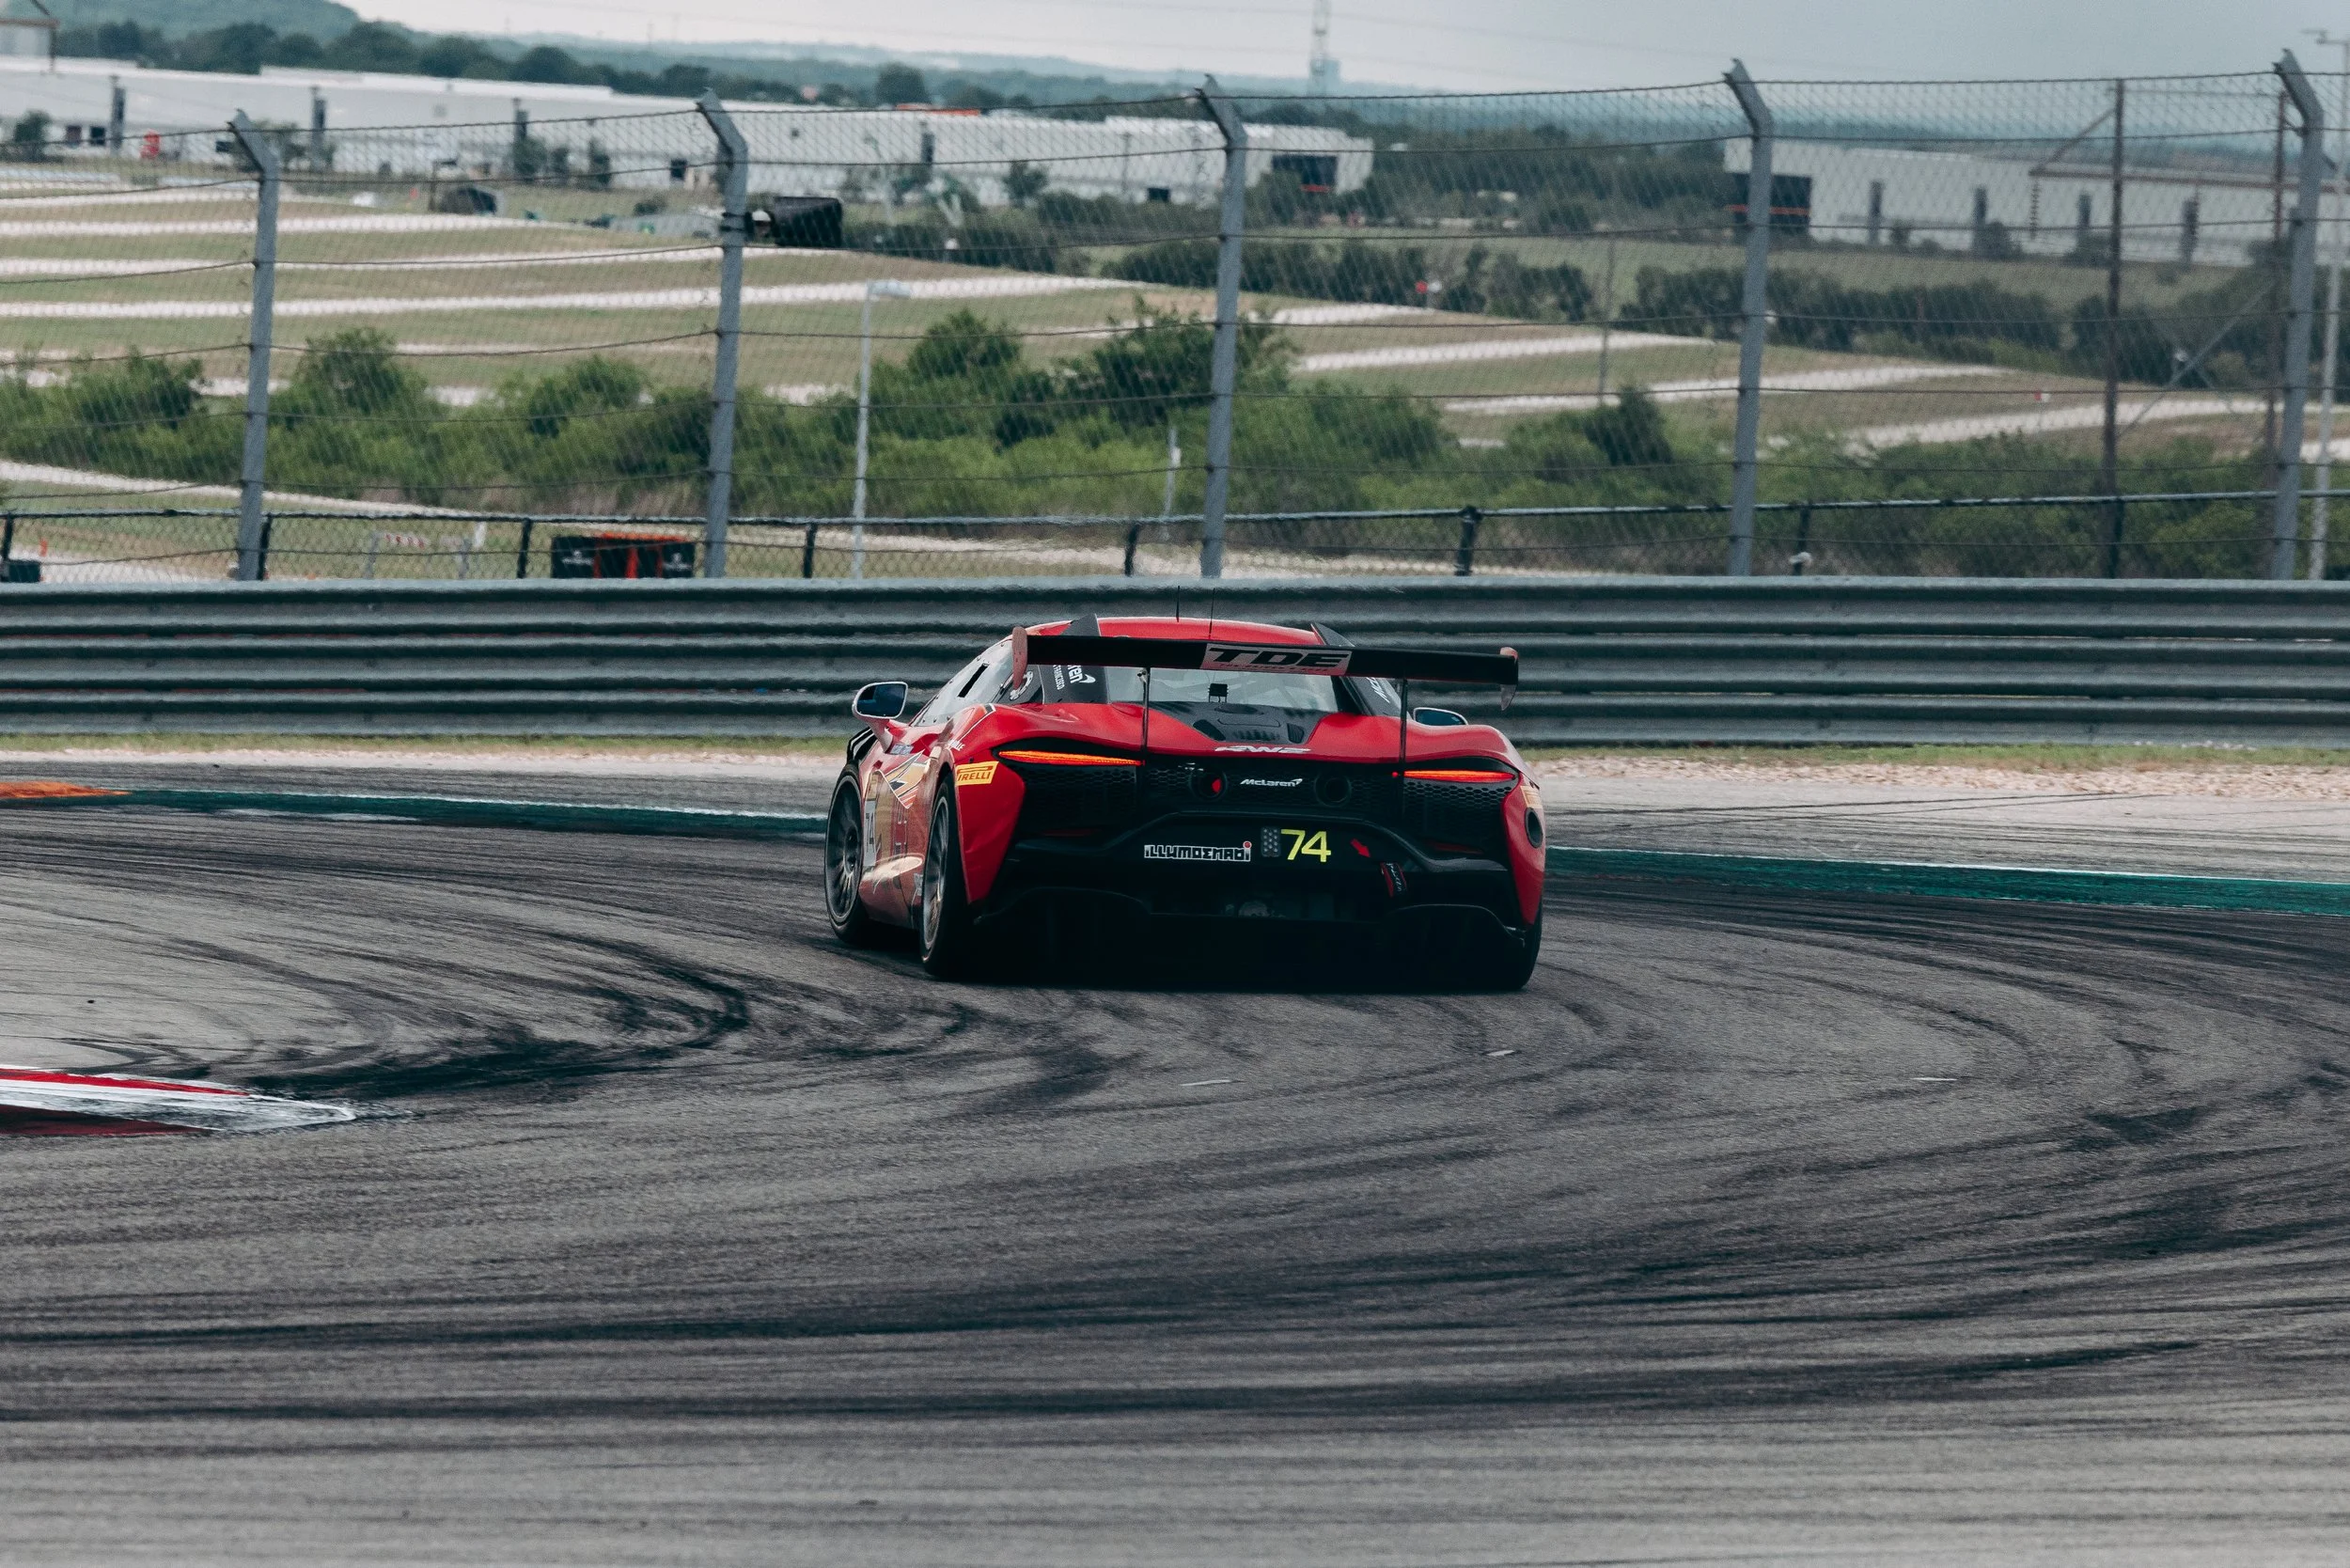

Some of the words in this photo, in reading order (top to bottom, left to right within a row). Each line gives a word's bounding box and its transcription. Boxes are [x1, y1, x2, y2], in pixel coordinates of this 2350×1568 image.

[1209, 647, 1349, 667] TDE
[1240, 778, 1298, 787] McLaren
[1280, 828, 1332, 863] 74
